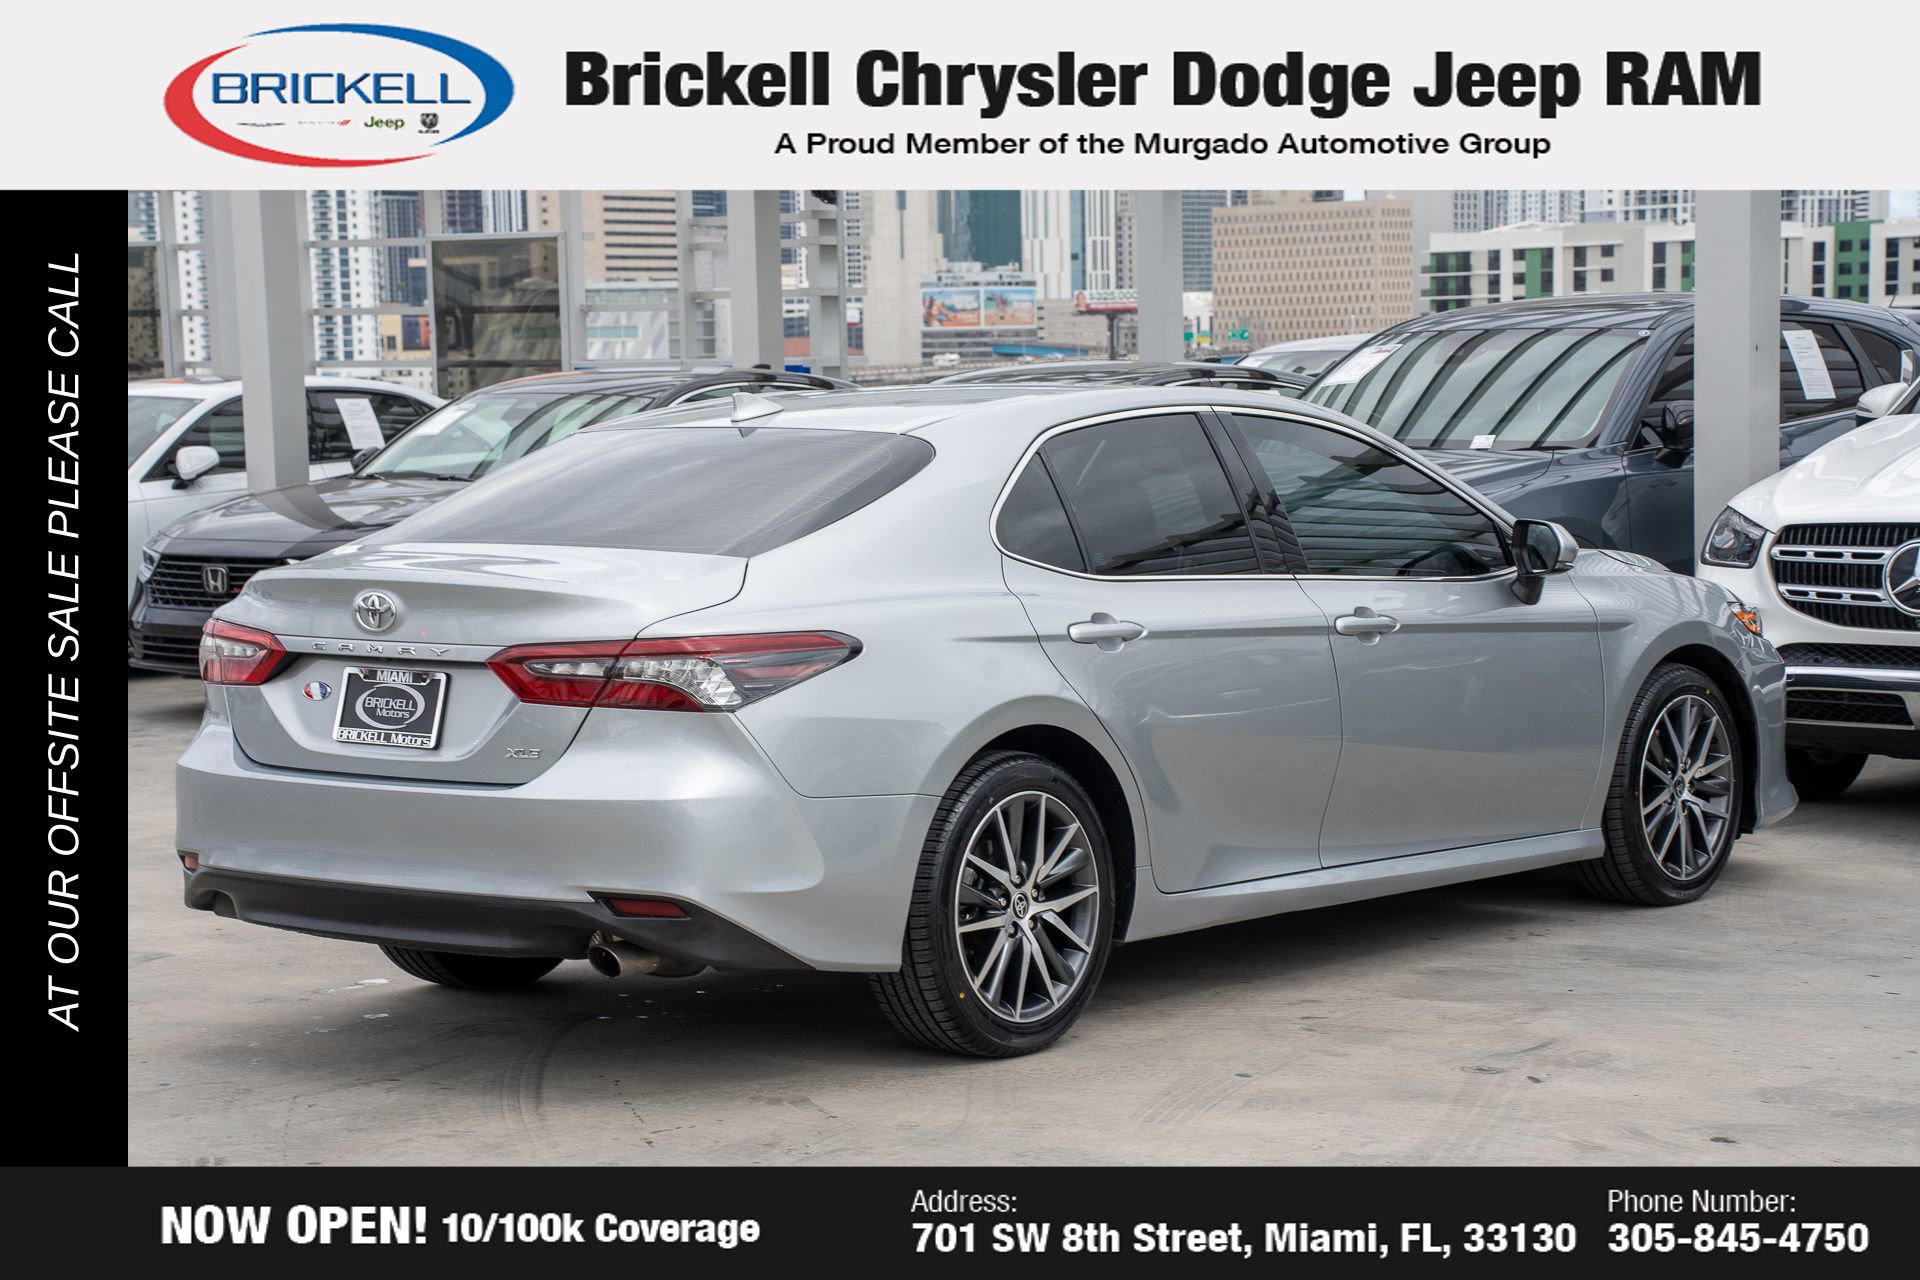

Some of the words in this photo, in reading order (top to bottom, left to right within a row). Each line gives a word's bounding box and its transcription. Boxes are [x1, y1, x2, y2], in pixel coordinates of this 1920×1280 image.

[312, 641, 450, 656] CAMRY
[376, 670, 413, 683] MIAMI
[365, 696, 416, 711] BRICKELL
[376, 708, 410, 719] Motors
[336, 729, 387, 743] BRICKELL
[390, 733, 431, 746] Motors
[504, 747, 541, 759] XLE
